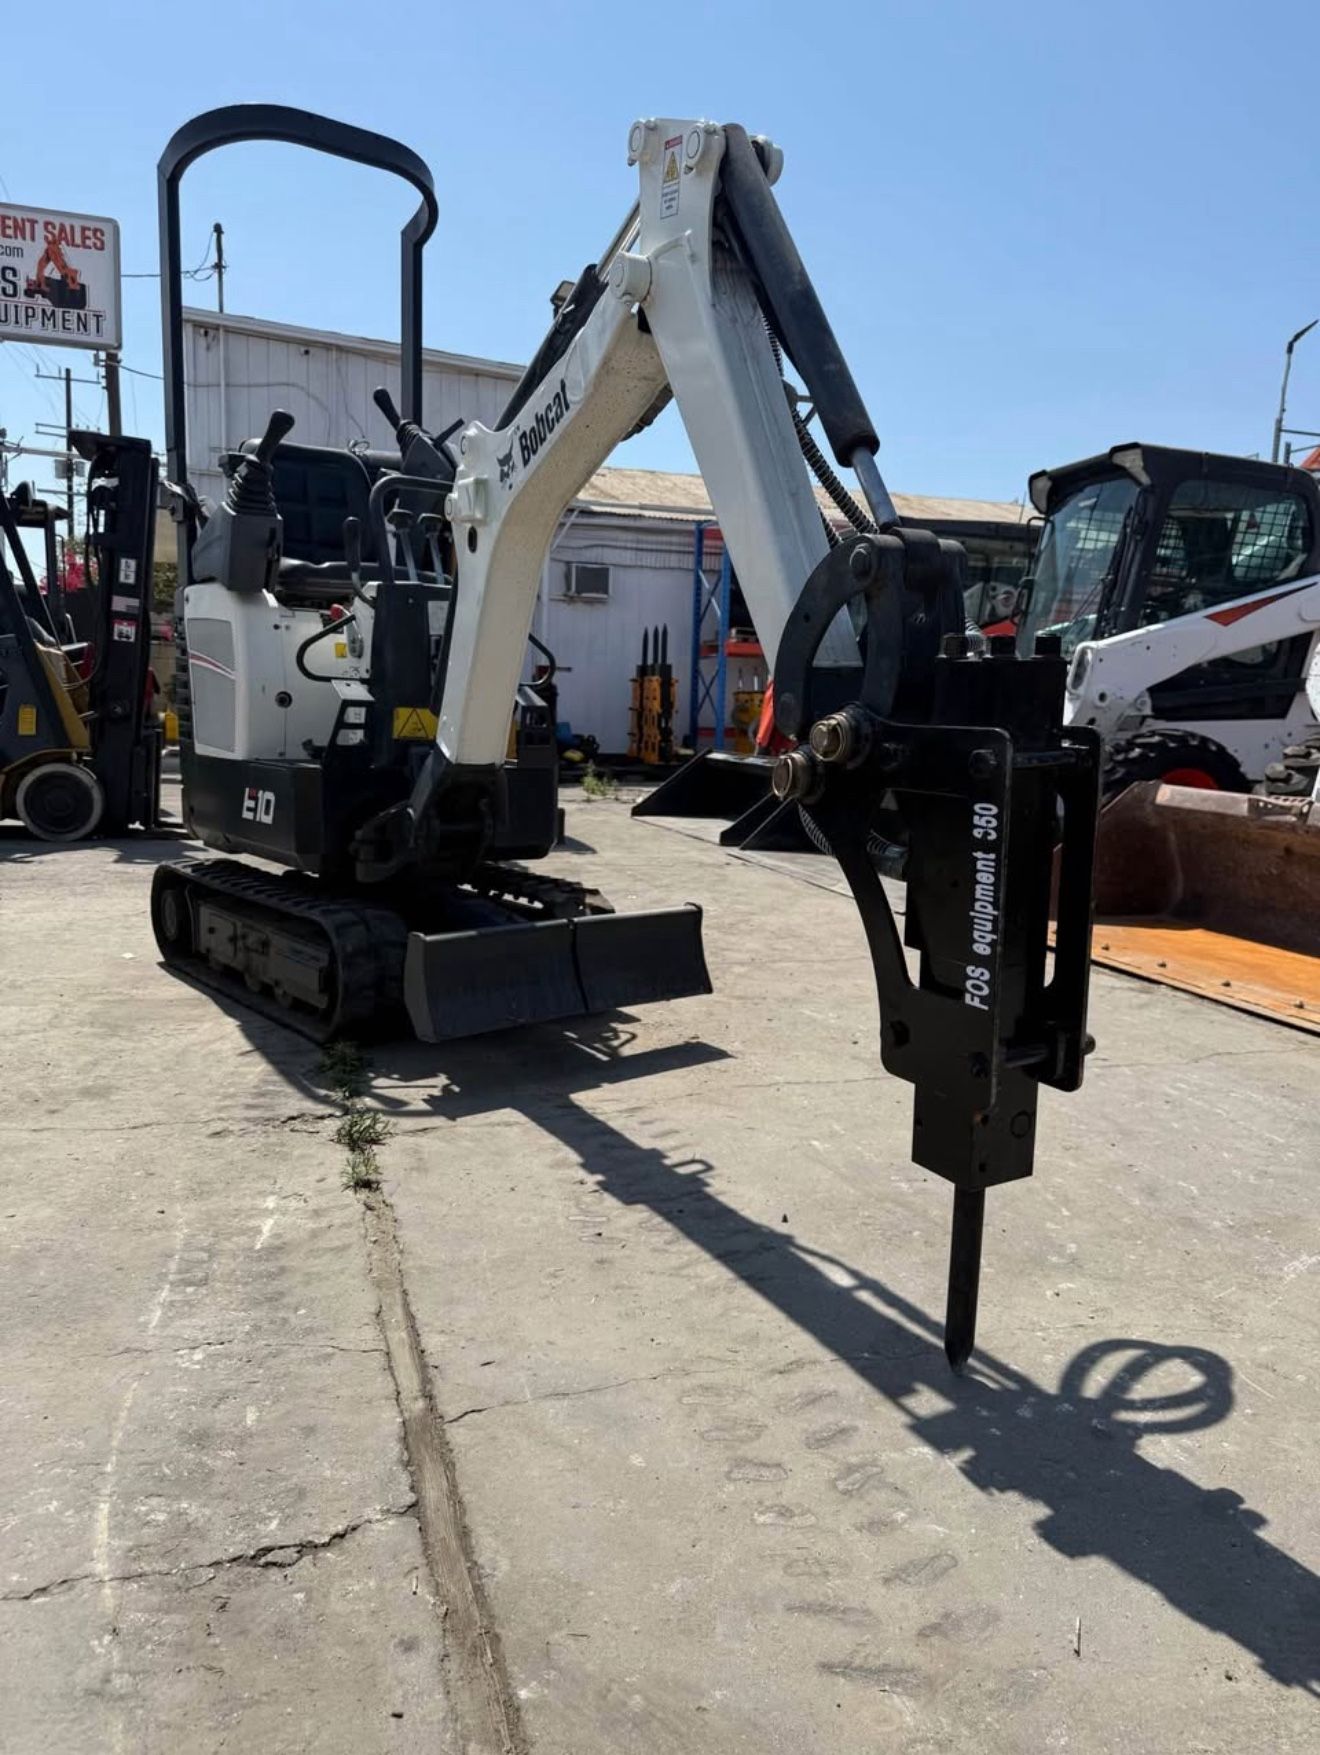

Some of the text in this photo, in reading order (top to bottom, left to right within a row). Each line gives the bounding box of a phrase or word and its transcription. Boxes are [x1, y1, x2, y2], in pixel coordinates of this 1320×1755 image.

[0, 214, 105, 251] ENT SALES
[519, 378, 570, 468] Bobcat
[241, 787, 276, 824] E10
[964, 802, 999, 1010] FOS equipment 350
